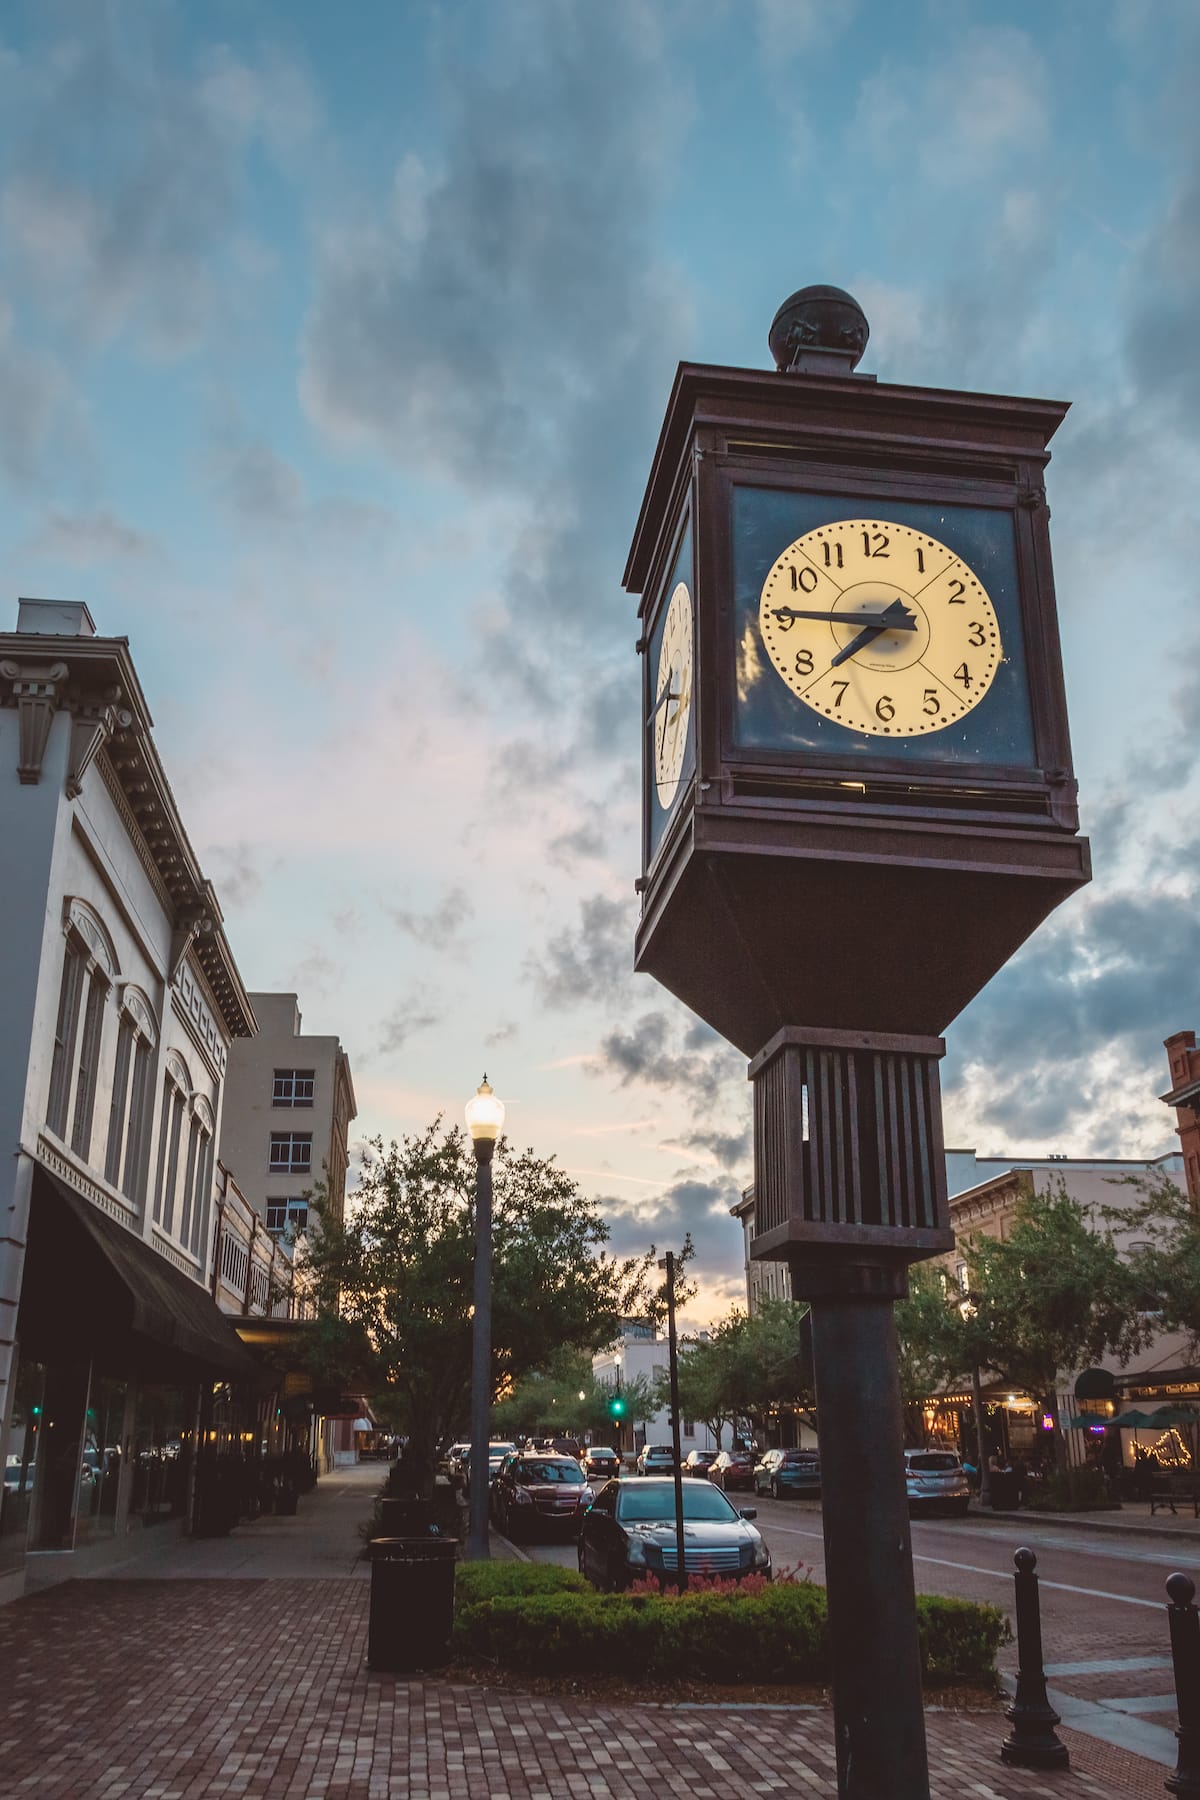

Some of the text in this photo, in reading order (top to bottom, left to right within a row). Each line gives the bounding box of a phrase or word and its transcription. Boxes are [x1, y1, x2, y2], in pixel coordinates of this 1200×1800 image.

[821, 541, 844, 569] 11
[861, 531, 890, 558] 12
[914, 547, 925, 574] 1
[788, 565, 818, 593] 10
[948, 579, 966, 605] 2
[776, 606, 795, 632] 9
[968, 621, 986, 647] 3
[795, 649, 814, 675] 8
[953, 662, 973, 689] 4
[831, 681, 850, 707] 7
[922, 689, 940, 716] 5
[875, 695, 895, 722] 6
